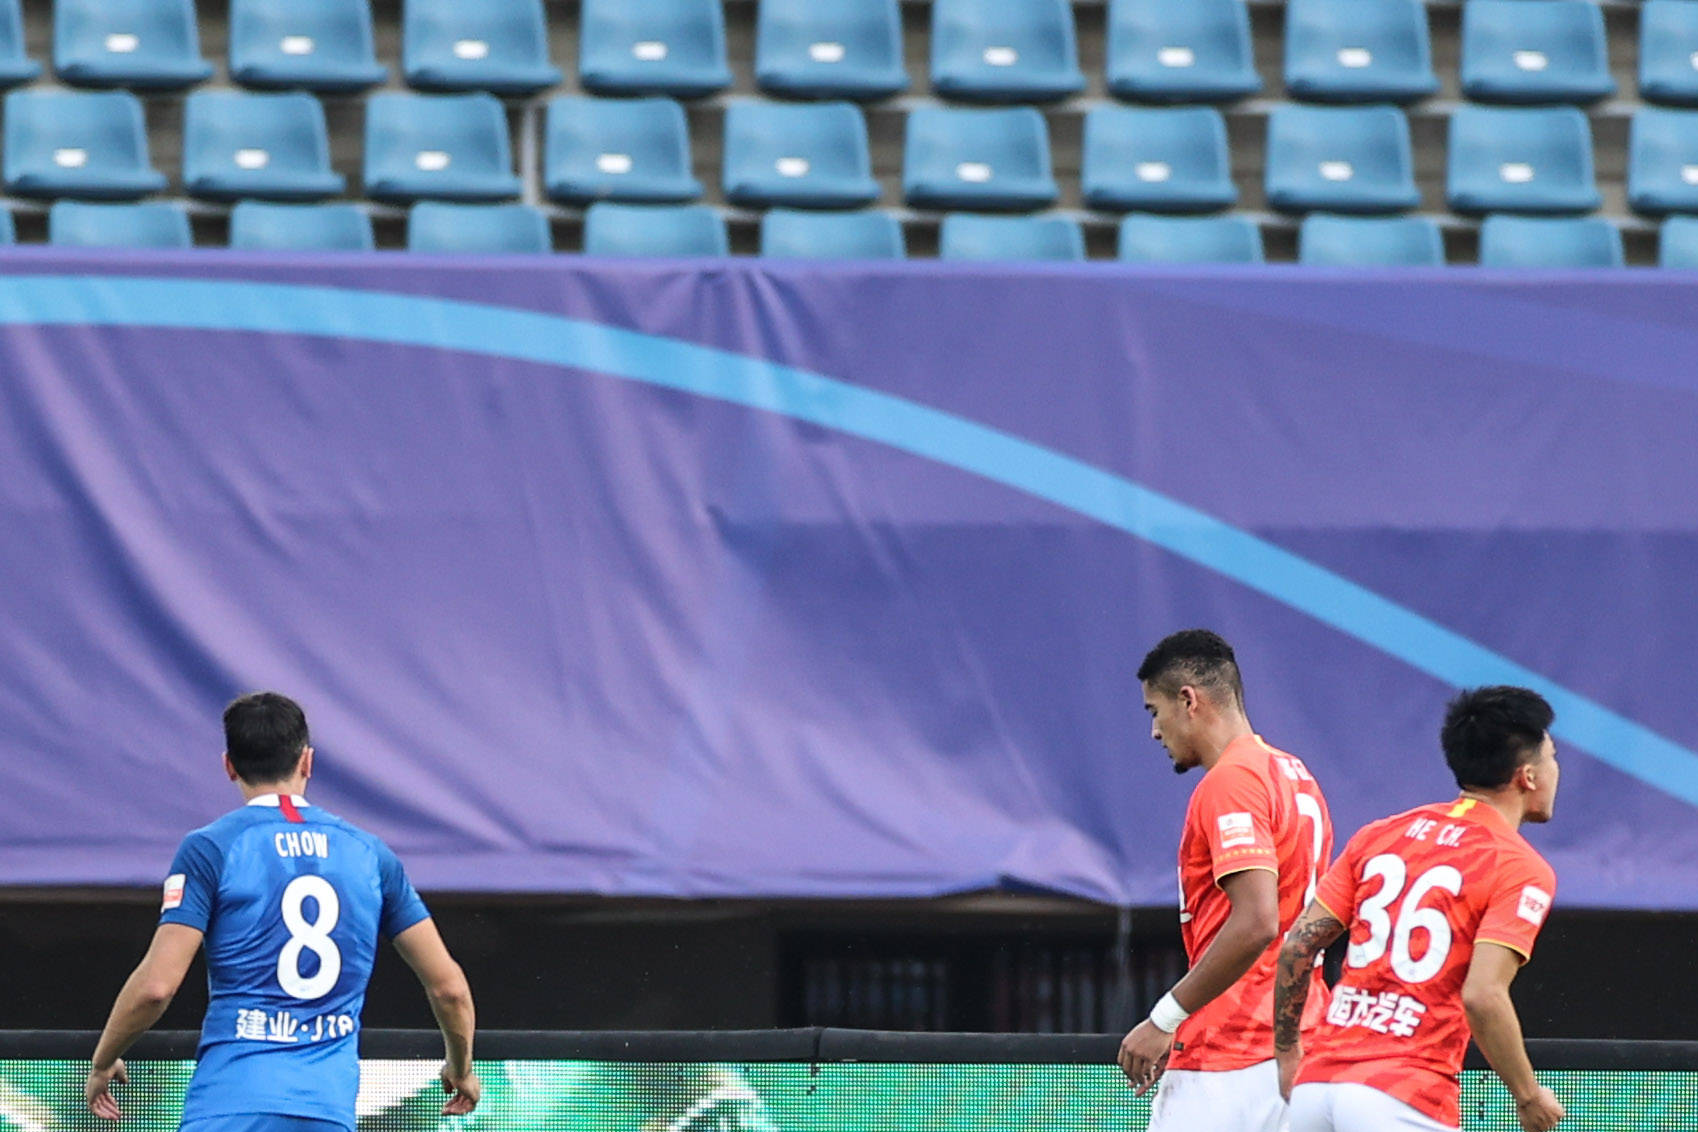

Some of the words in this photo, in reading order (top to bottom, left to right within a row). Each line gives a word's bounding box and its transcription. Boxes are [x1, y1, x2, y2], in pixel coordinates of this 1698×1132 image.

[274, 831, 328, 858] CHOW
[1405, 818, 1437, 840] HE
[277, 874, 341, 1000] 8
[1347, 853, 1463, 983] 36
